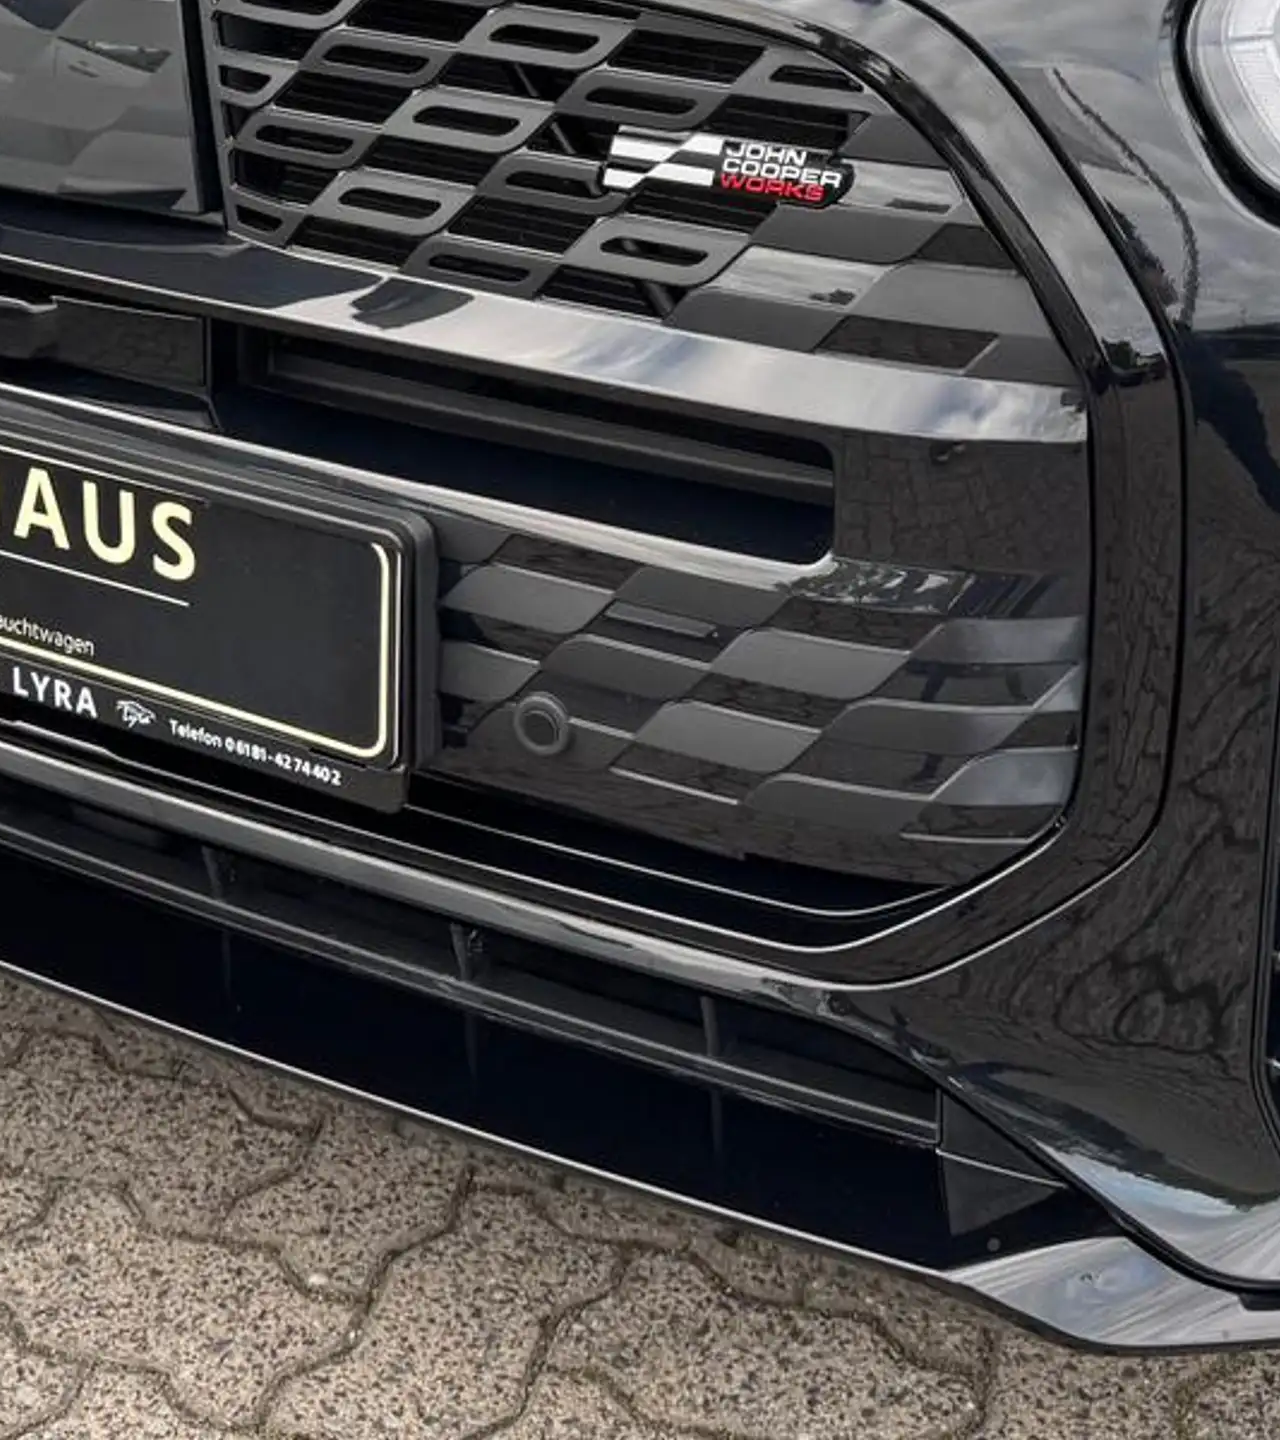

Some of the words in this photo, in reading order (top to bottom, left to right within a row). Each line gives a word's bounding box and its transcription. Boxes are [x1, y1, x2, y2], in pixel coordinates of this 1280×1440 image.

[724, 140, 807, 166] JOHN
[720, 174, 825, 201] WORKS
[721, 157, 842, 188] COOPER
[12, 667, 99, 718] LYRA
[169, 719, 222, 748] Telefon
[224, 738, 342, 786] 06181-4274402
